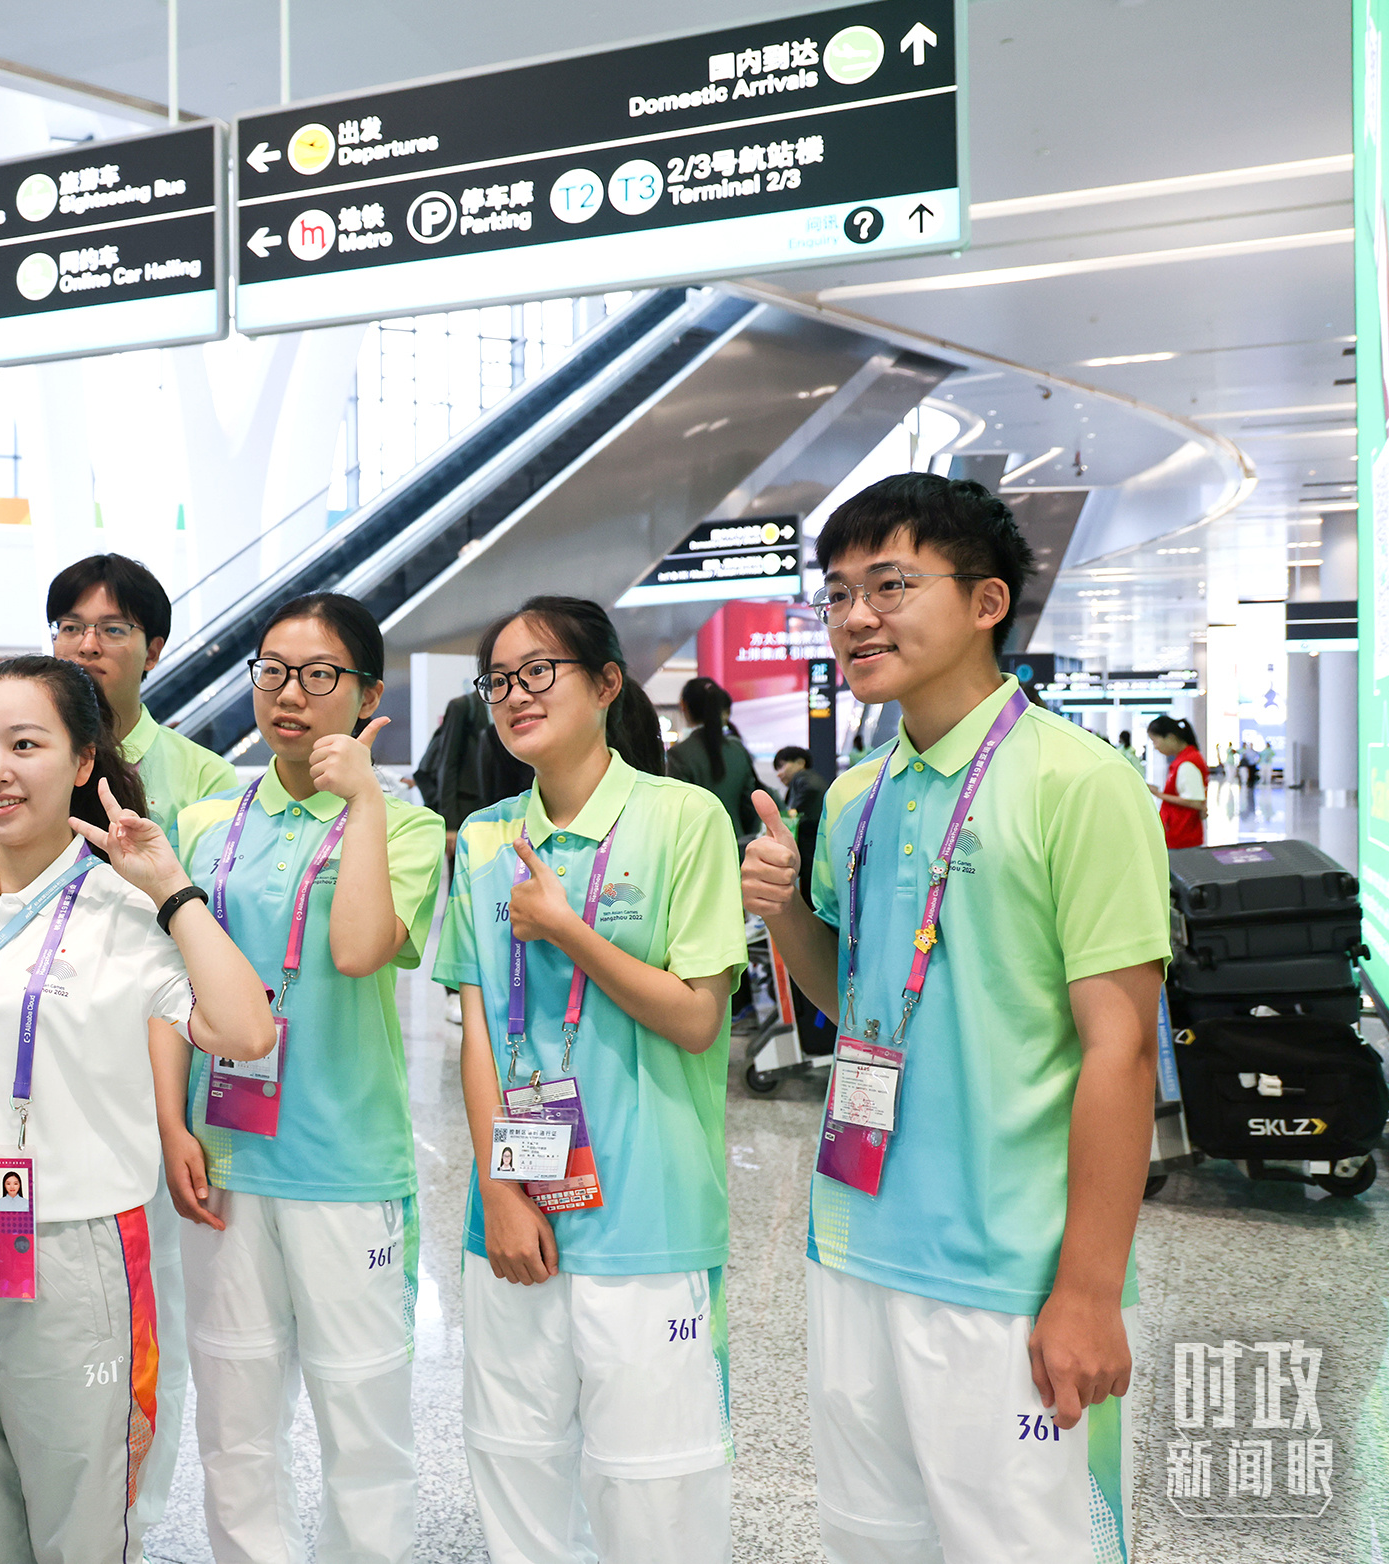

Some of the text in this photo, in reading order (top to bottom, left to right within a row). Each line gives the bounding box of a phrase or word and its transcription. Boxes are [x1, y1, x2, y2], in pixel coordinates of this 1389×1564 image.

[709, 37, 819, 82] 国内到达
[629, 68, 819, 118] Domestic Arrivals
[338, 115, 382, 145] 出发
[338, 136, 439, 166] Departures
[667, 135, 824, 184] 2/3号航站楼
[59, 179, 186, 214] Sightseeing Bus
[460, 180, 534, 215] 停车库
[558, 183, 595, 210] T2
[617, 174, 656, 202] T3
[667, 168, 802, 206] Terminal 2/3
[338, 203, 385, 231] 地铁
[460, 210, 532, 236] Parking
[806, 213, 839, 233] 问讯
[338, 231, 394, 253] Metro
[788, 233, 841, 251] Enquiry
[59, 259, 202, 293] Online Car Hailing
[963, 740, 996, 799] 杭州第19届亚运会
[944, 822, 959, 856] Hangzhou
[962, 866, 976, 874] 2022
[591, 874, 601, 902] Hangzhou
[495, 902, 509, 922] 36
[928, 896, 939, 919] Alibaba
[54, 989, 69, 998] 2022
[24, 994, 36, 1032] Alibaba Cloud
[1248, 1118, 1314, 1136] SKLZ
[366, 1241, 397, 1269] 361°
[667, 1314, 704, 1342] 361°
[83, 1355, 124, 1387] 361°
